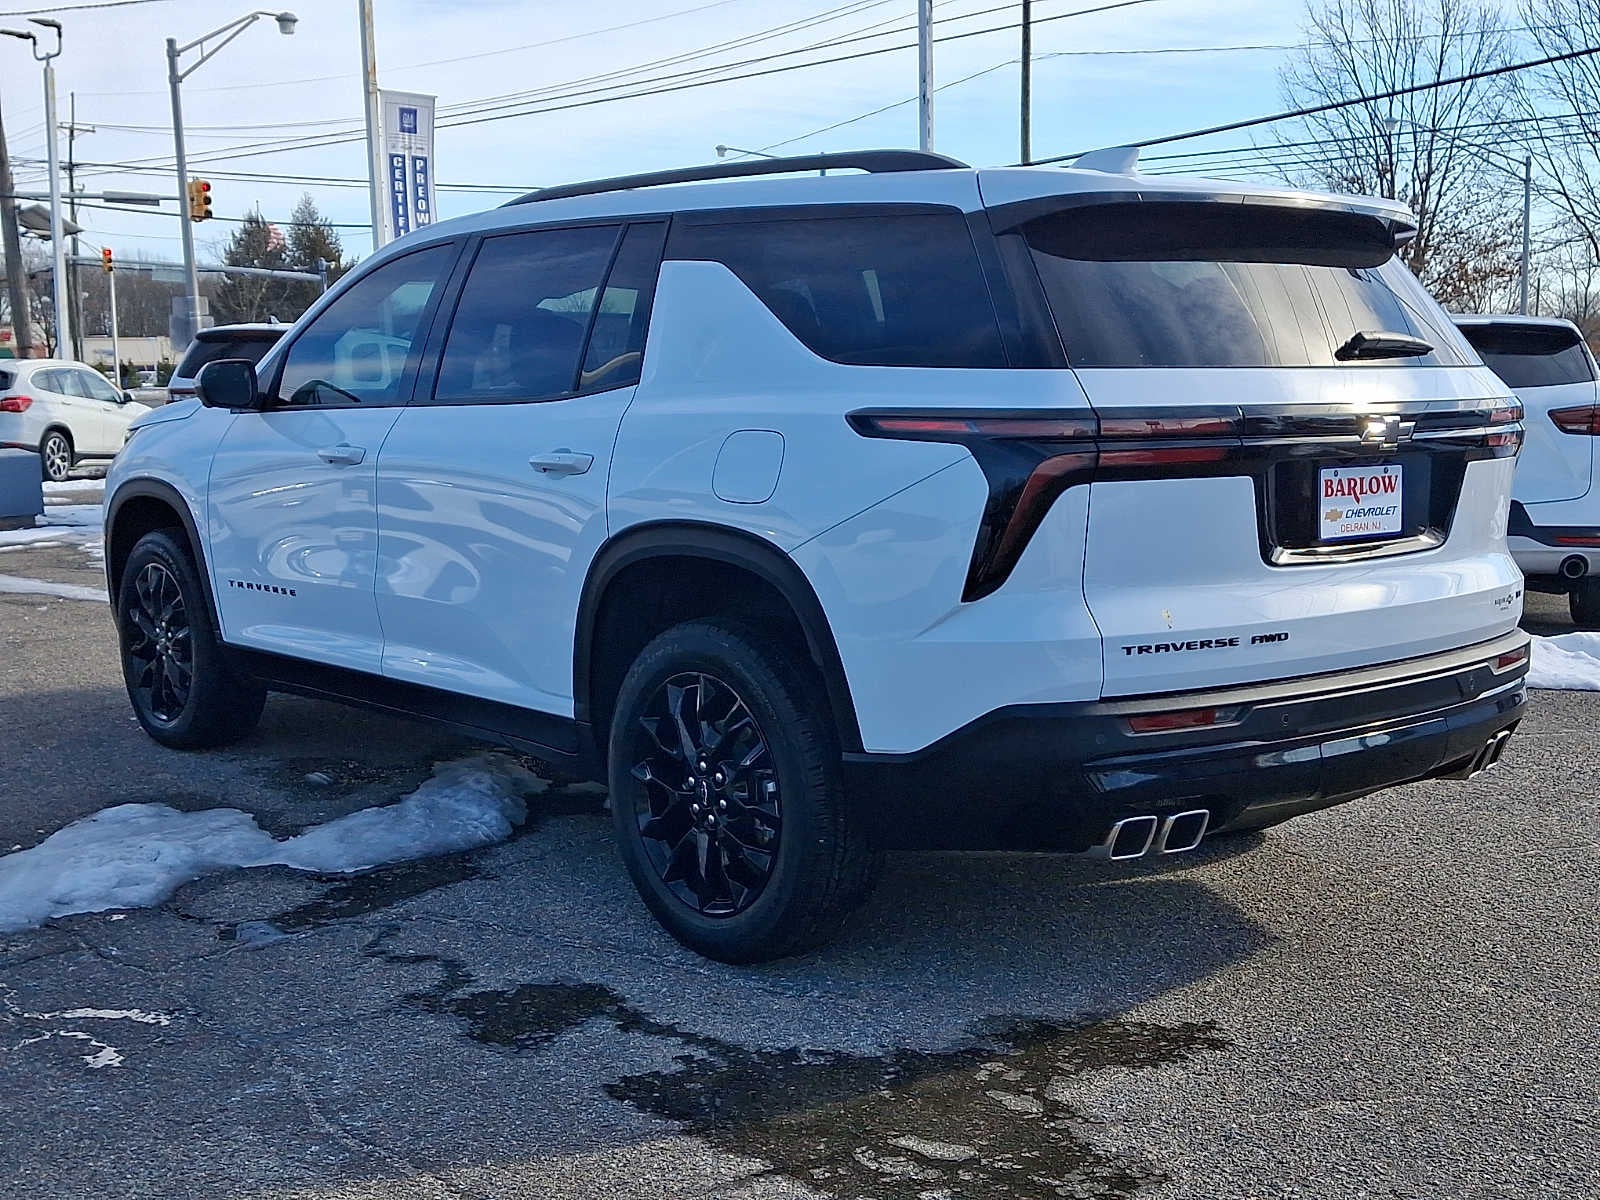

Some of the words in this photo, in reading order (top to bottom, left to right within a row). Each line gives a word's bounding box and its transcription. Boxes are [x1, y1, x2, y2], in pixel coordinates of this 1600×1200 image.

[1324, 475, 1398, 504] BARLOW
[1345, 506, 1397, 519] CHEVROLET
[1372, 521, 1381, 531] NJ
[228, 579, 296, 597] TRAVERSE
[1121, 637, 1240, 656] TRAVERSE
[1251, 632, 1289, 645] AWD
